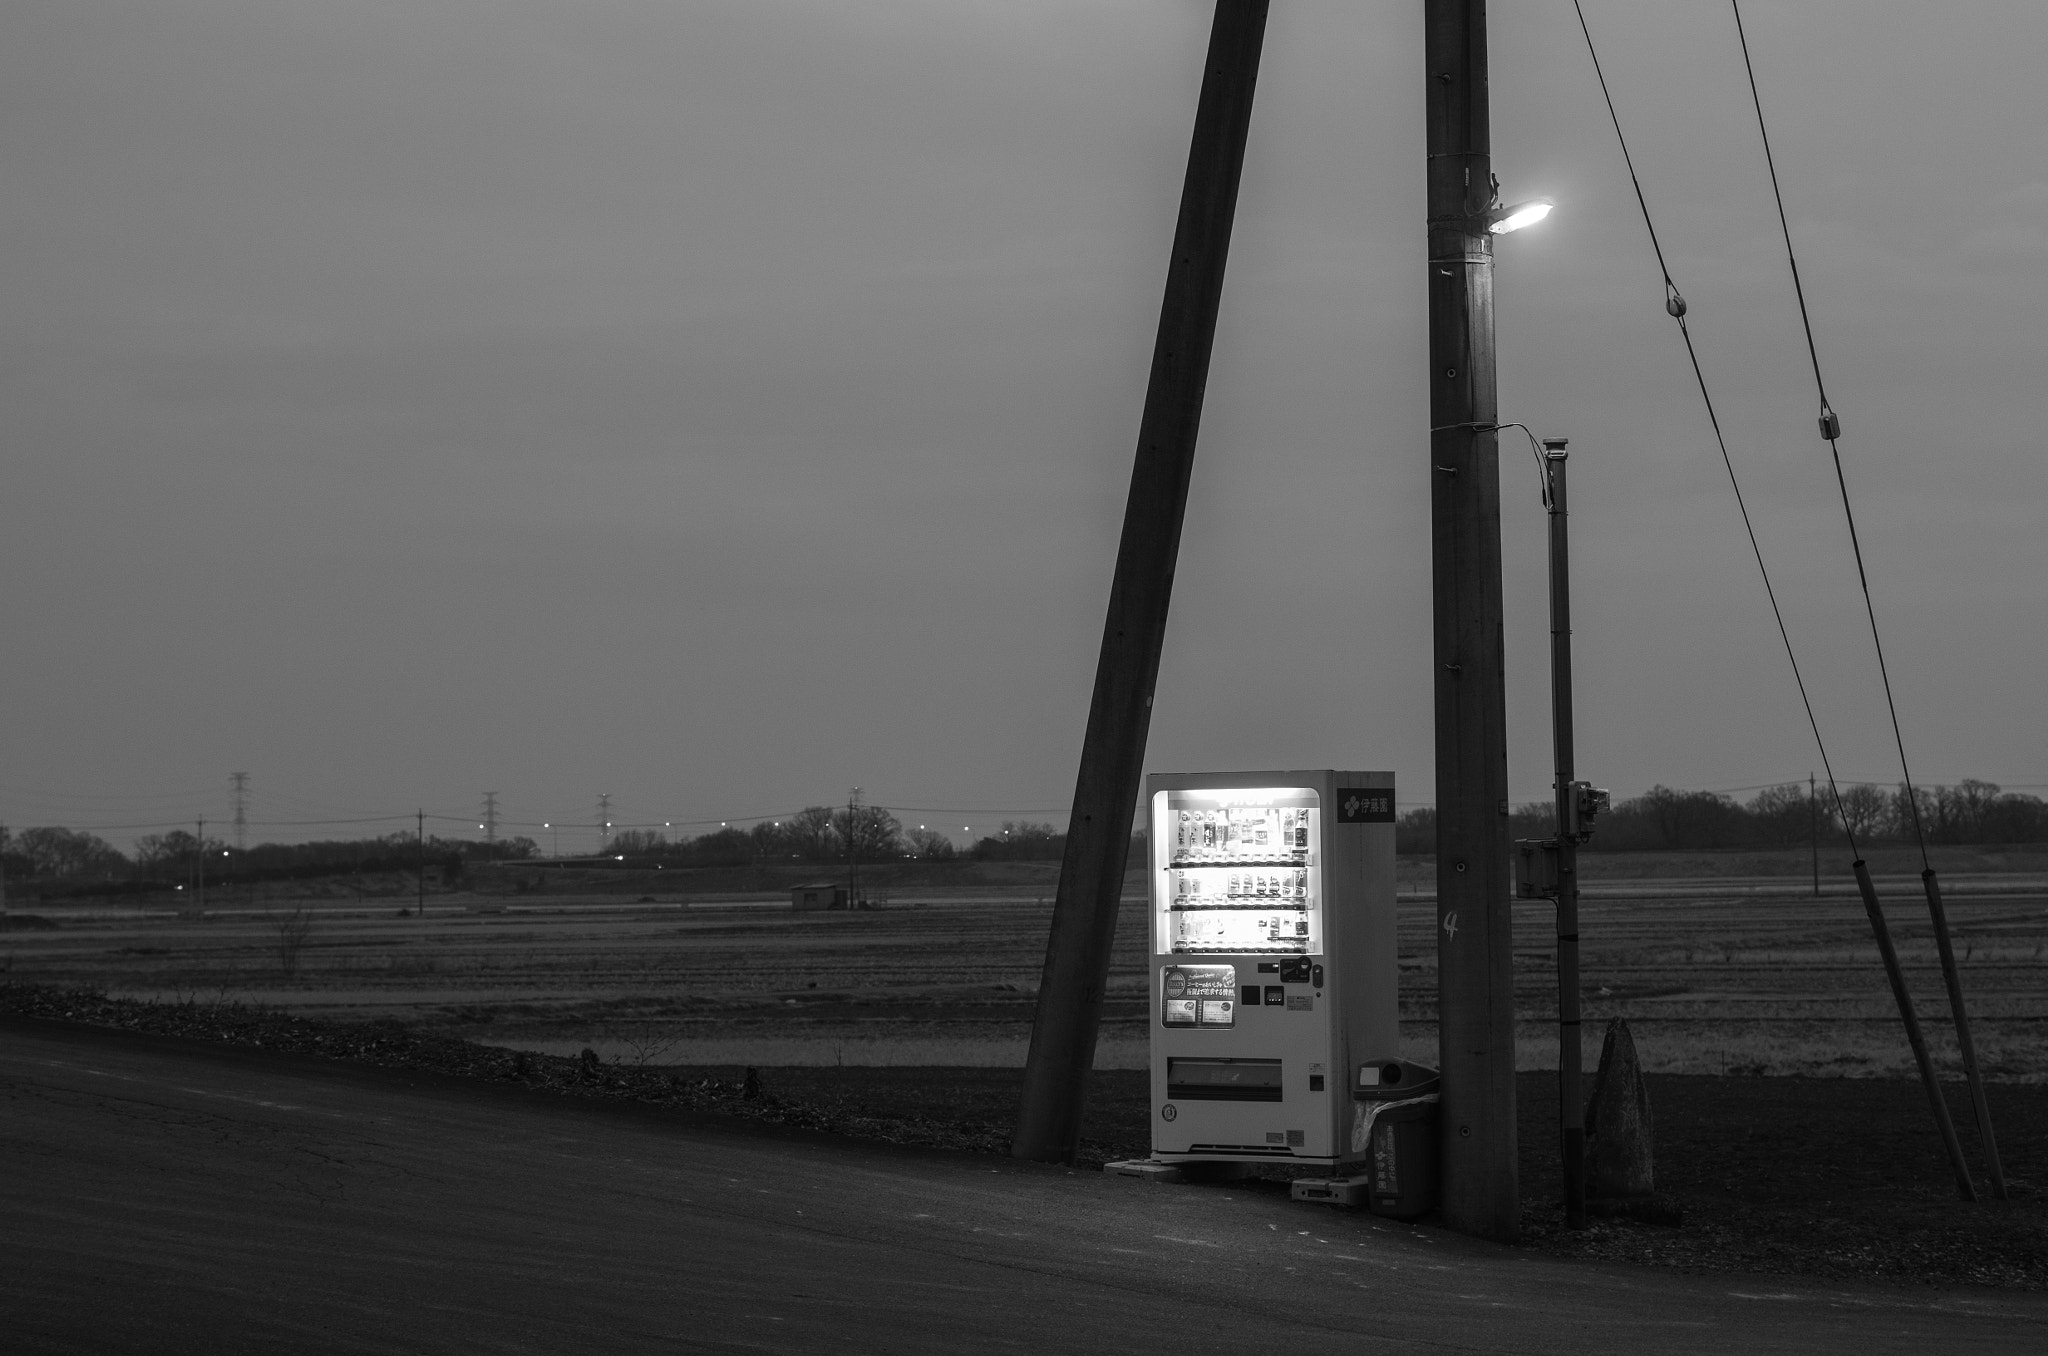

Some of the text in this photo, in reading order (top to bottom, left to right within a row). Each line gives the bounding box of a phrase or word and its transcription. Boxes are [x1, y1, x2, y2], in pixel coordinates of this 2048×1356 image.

[1360, 797, 1388, 814] 伊藤園
[1443, 911, 1459, 942] 4
